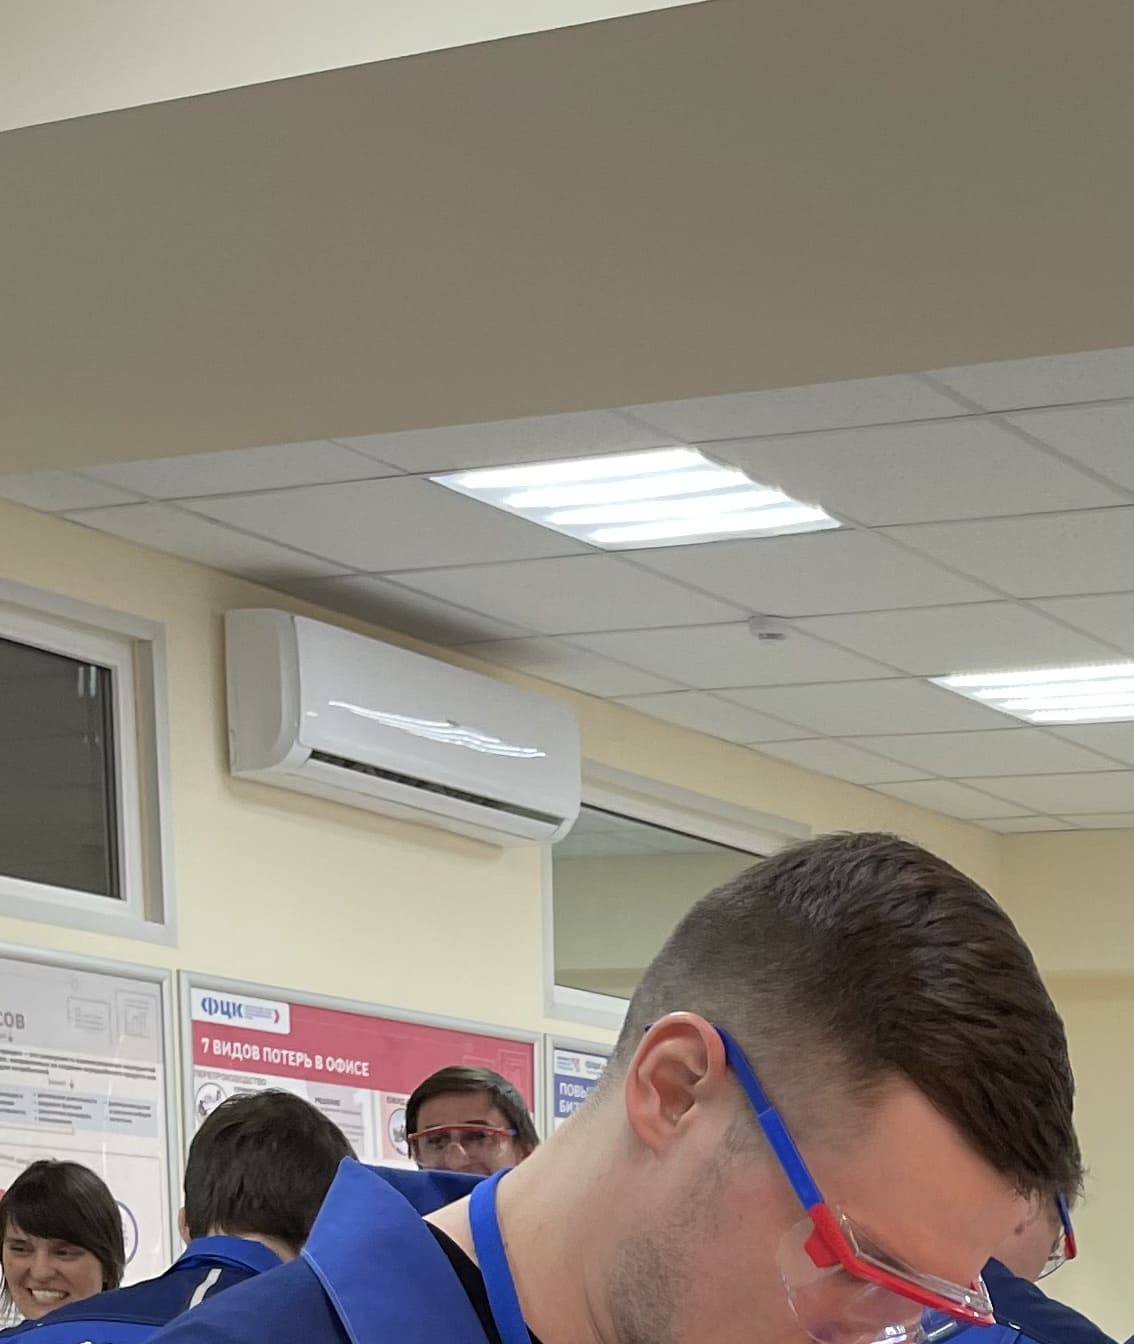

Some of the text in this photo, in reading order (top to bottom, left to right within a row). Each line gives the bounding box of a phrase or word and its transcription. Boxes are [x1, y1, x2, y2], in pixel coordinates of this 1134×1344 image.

[202, 997, 243, 1018] ФЦК
[201, 1038, 370, 1077] 7 ВИДОВ ПОТЕРЬ В ОФИСЕ
